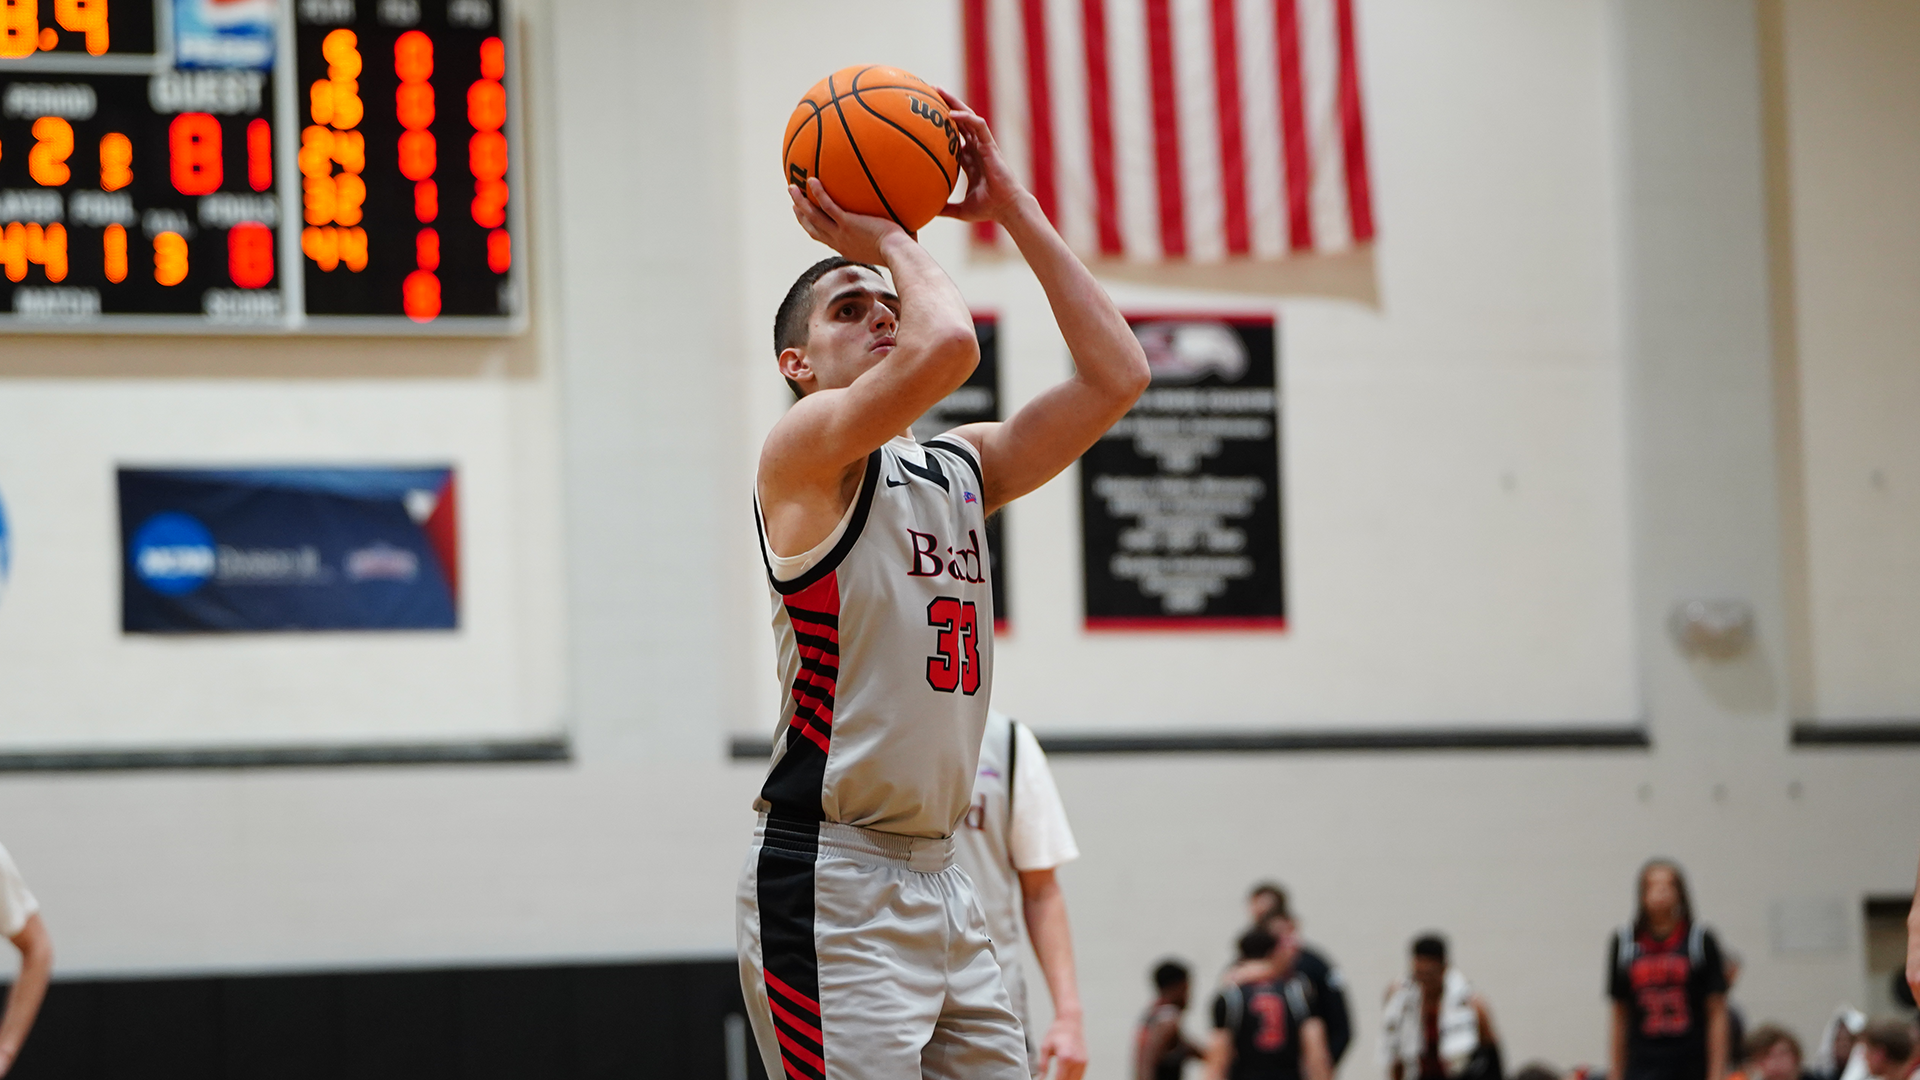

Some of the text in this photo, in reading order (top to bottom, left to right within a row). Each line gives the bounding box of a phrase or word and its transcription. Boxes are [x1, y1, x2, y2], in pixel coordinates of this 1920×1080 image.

[29, 116, 74, 187] 2
[169, 112, 272, 196] 81
[104, 222, 128, 284] 1
[926, 596, 981, 696] 33
